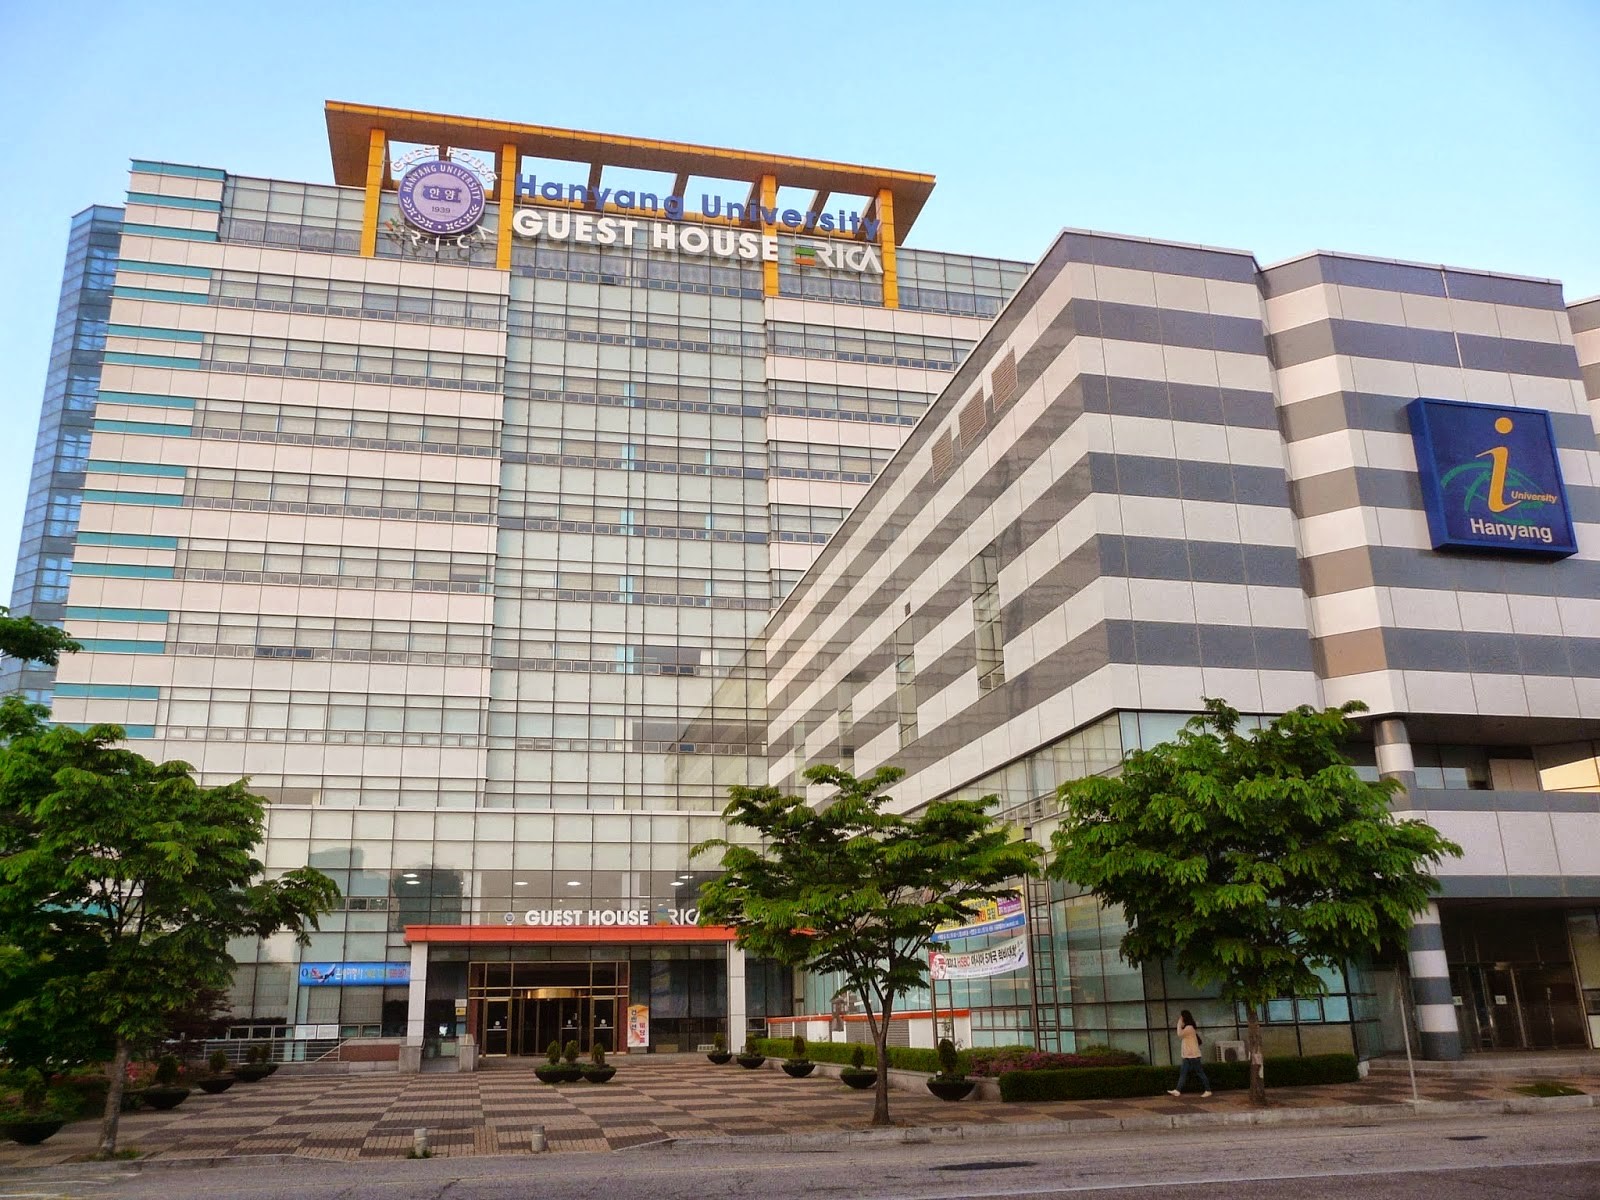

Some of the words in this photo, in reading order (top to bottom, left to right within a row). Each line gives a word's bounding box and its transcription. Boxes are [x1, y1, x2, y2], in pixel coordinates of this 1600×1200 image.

[391, 145, 440, 171] GUEST
[446, 146, 498, 183] HOUSE
[402, 164, 437, 193] HANYANG
[440, 164, 481, 200] UNIVERSITY
[429, 187, 456, 201] 한양
[431, 206, 451, 214] 1939
[516, 173, 684, 220] Hanyang
[701, 194, 881, 242] University
[512, 209, 639, 247] GUEST
[653, 222, 779, 262] HOUSE
[1511, 490, 1558, 504] University
[1470, 518, 1554, 543] Hanyang
[524, 909, 583, 926] GUEST
[588, 909, 649, 926] HOUSE
